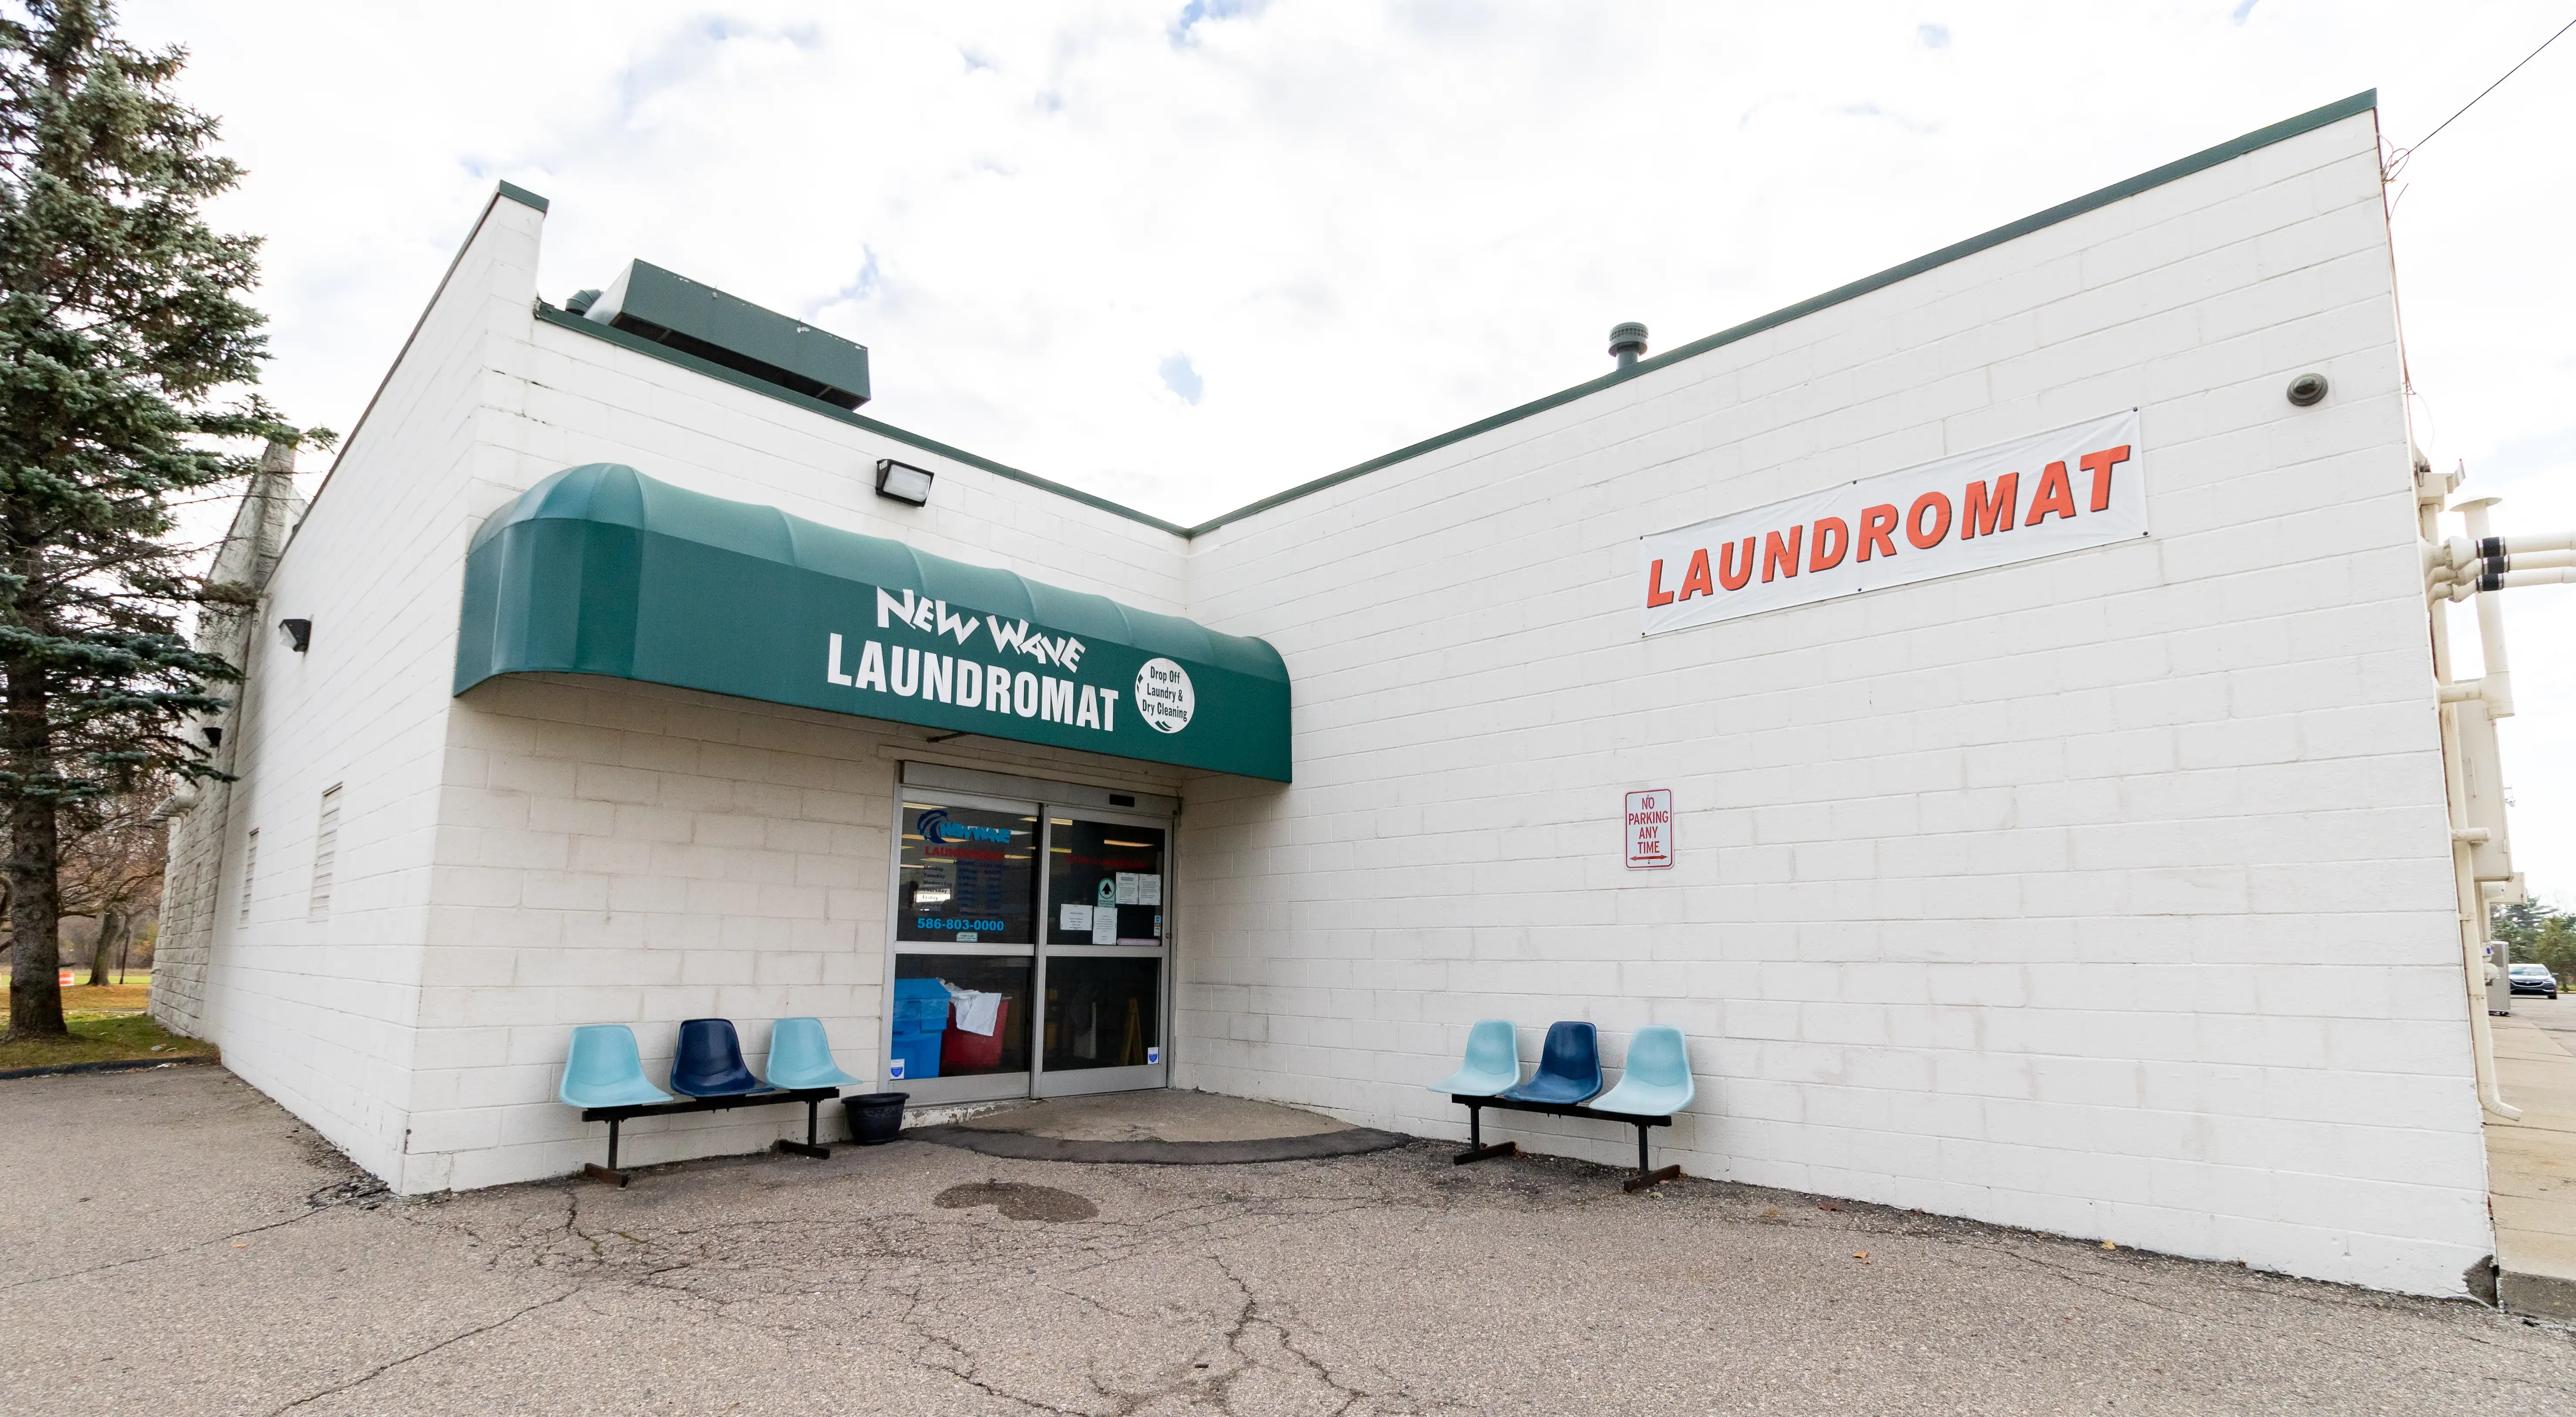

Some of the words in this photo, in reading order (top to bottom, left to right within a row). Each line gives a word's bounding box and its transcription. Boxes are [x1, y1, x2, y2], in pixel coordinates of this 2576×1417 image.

[1647, 444, 2131, 609] LAUNDROMAT
[877, 586, 980, 645] NEW
[986, 615, 1086, 673] WAVE
[827, 632, 1119, 732] LAUNDROMAT
[1150, 666, 1167, 684] Drop
[1169, 670, 1180, 684] Off
[1147, 683, 1176, 703] Laundry
[1178, 689, 1183, 702] &
[1142, 699, 1155, 716] Dry
[1157, 702, 1187, 722] Cleaning
[1642, 797, 1654, 810] NO
[1628, 811, 1668, 825] PARKING
[1639, 826, 1658, 839] ANY
[1637, 841, 1660, 854] TIME
[917, 917, 1004, 931] 586-803-0000
